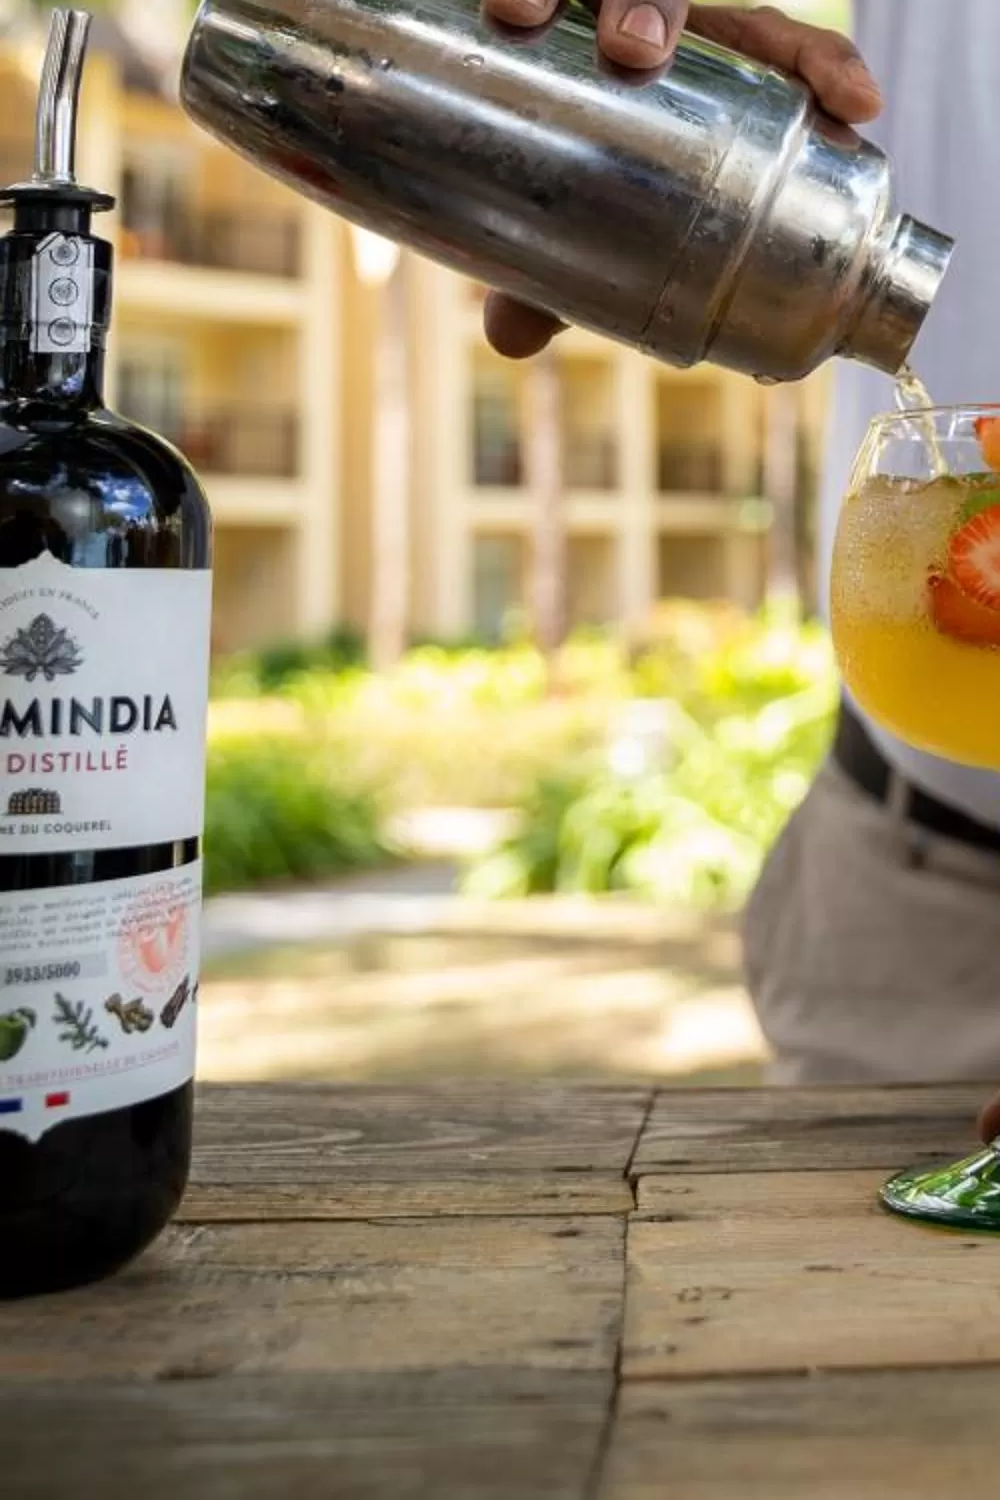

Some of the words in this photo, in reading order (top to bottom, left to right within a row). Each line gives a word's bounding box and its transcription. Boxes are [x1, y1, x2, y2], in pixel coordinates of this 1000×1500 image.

[7, 744, 128, 774] DISTILLÉ
[20, 823, 39, 835] DU
[43, 819, 112, 833] COQUEREL
